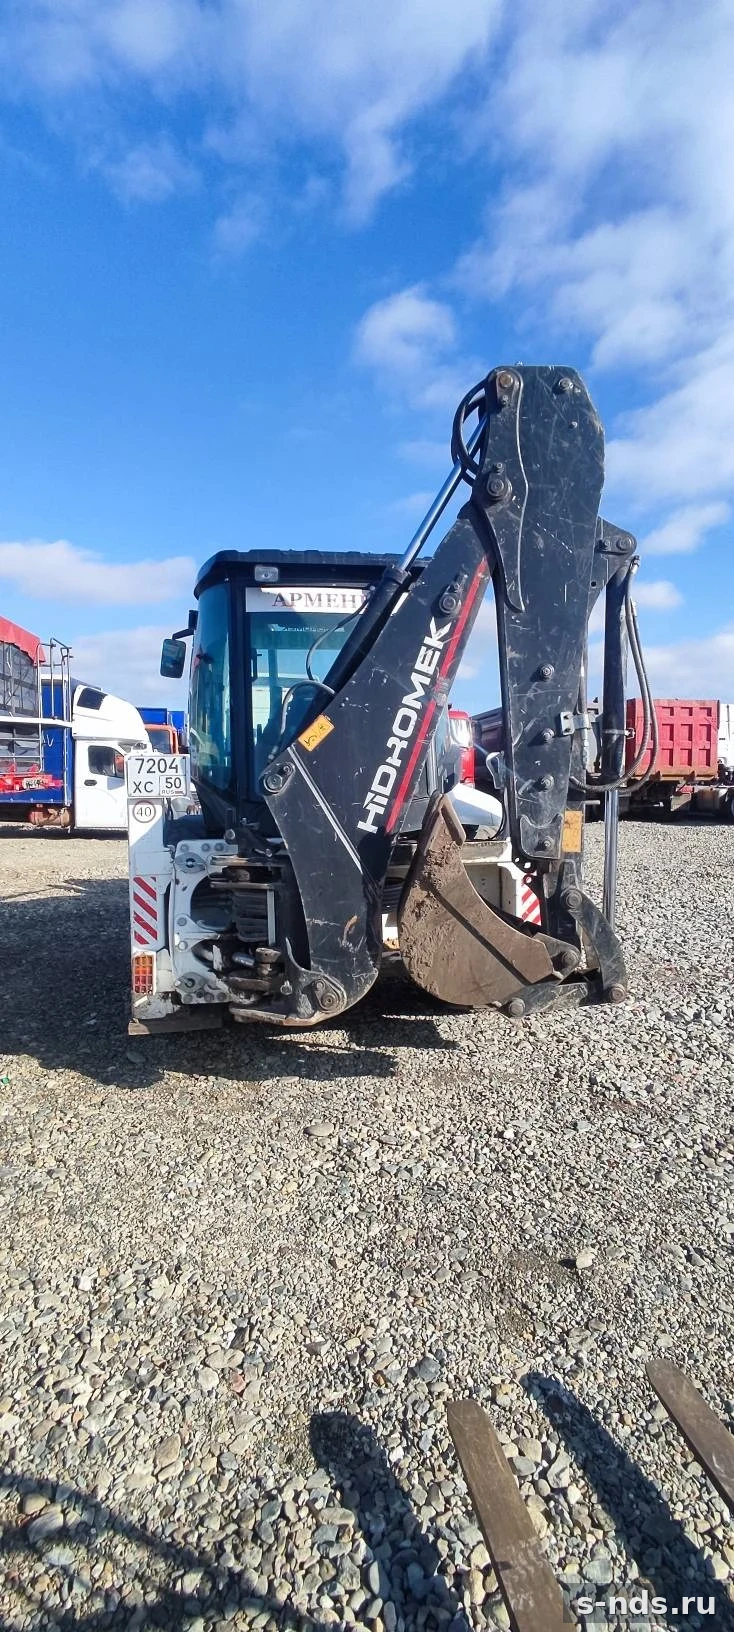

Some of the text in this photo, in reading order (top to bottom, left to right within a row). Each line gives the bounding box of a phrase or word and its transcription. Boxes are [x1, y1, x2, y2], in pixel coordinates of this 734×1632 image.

[357, 616, 452, 834] HIDROMEK
[135, 758, 178, 774] 7204
[165, 777, 182, 789] 50
[136, 806, 152, 817] 40
